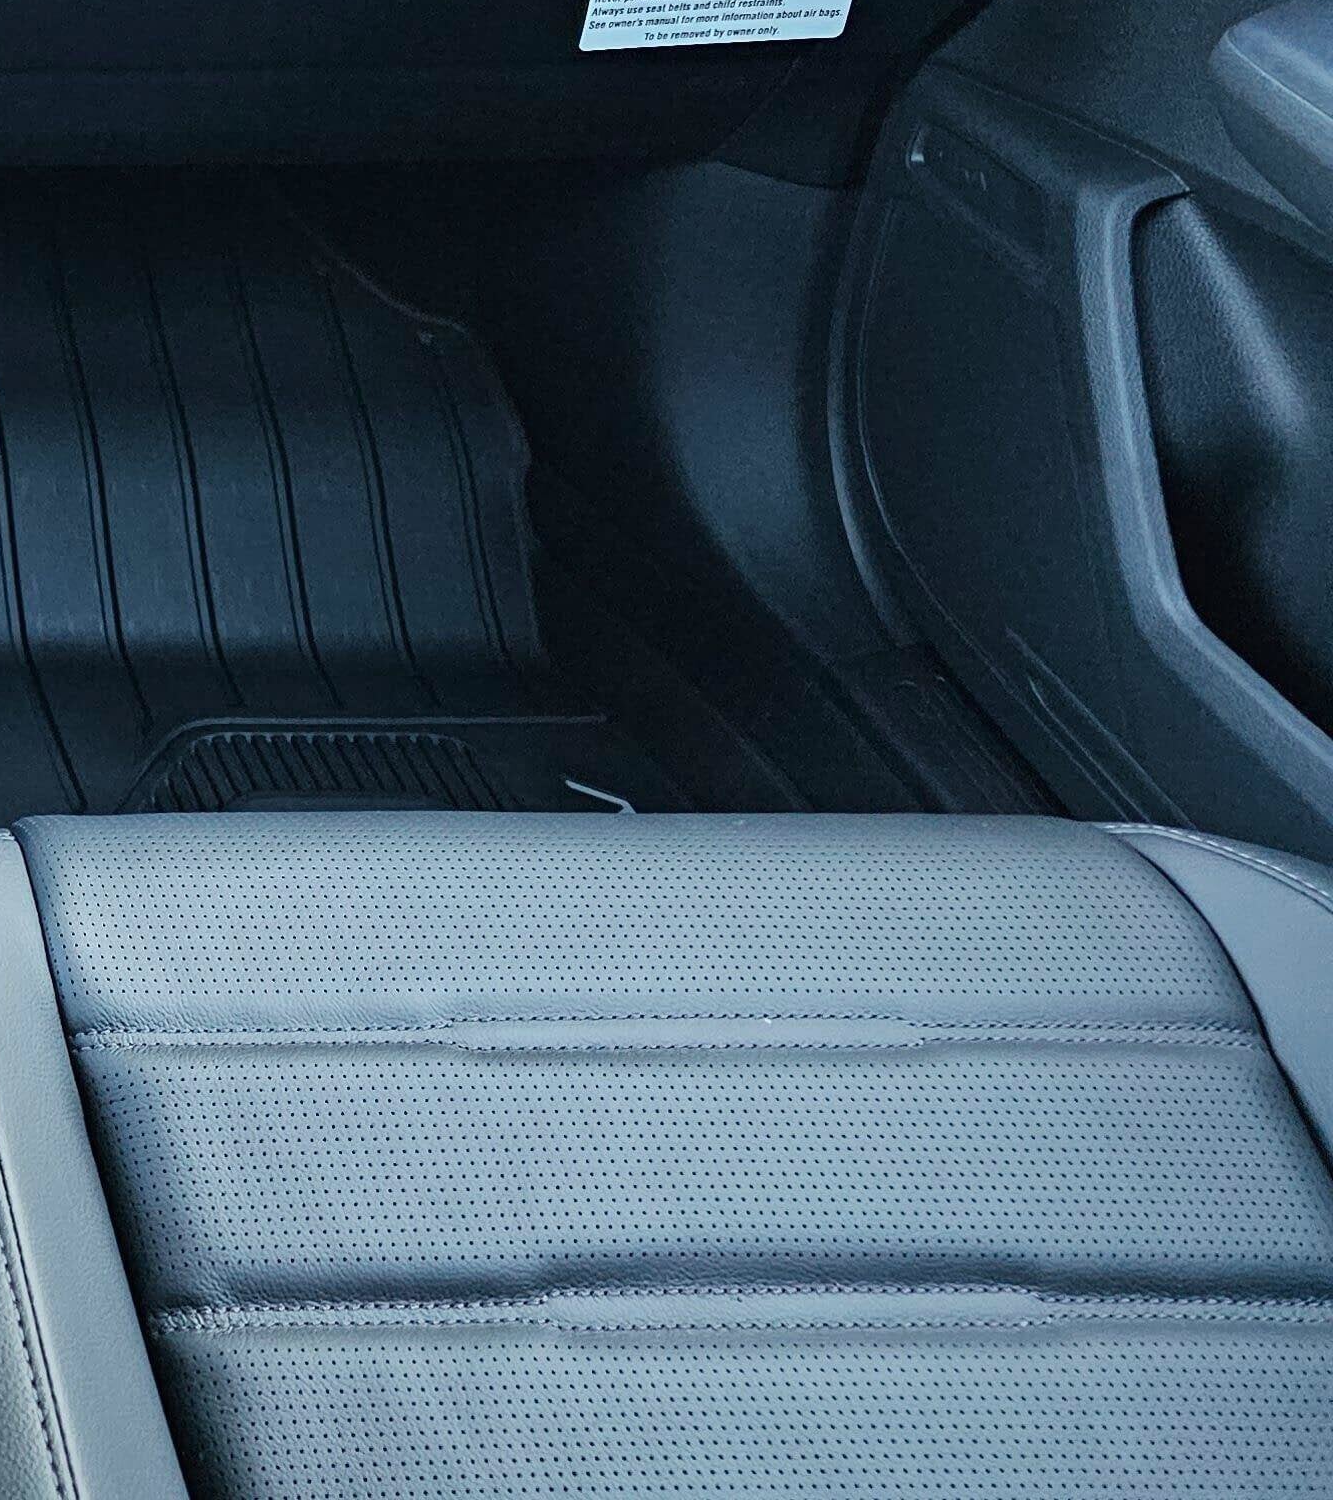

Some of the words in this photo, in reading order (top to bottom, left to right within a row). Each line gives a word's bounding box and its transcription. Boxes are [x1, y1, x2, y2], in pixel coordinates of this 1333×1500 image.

[592, 7, 624, 16] Always
[645, 4, 666, 13] seat
[668, 2, 691, 11] belts
[693, 1, 711, 10] and
[713, 0, 736, 9] child
[589, 20, 606, 29] See
[608, 18, 643, 28] owner's
[645, 16, 680, 26] manual
[681, 15, 694, 24] for
[696, 15, 719, 23] more
[721, 11, 774, 21] information
[776, 10, 802, 19] about
[804, 9, 817, 17] air
[819, 9, 844, 18] bags.
[644, 32, 655, 41] To
[657, 31, 669, 40] be
[671, 29, 711, 39] removed
[713, 29, 725, 38] by
[727, 28, 755, 36] owner
[757, 26, 780, 36] only.
